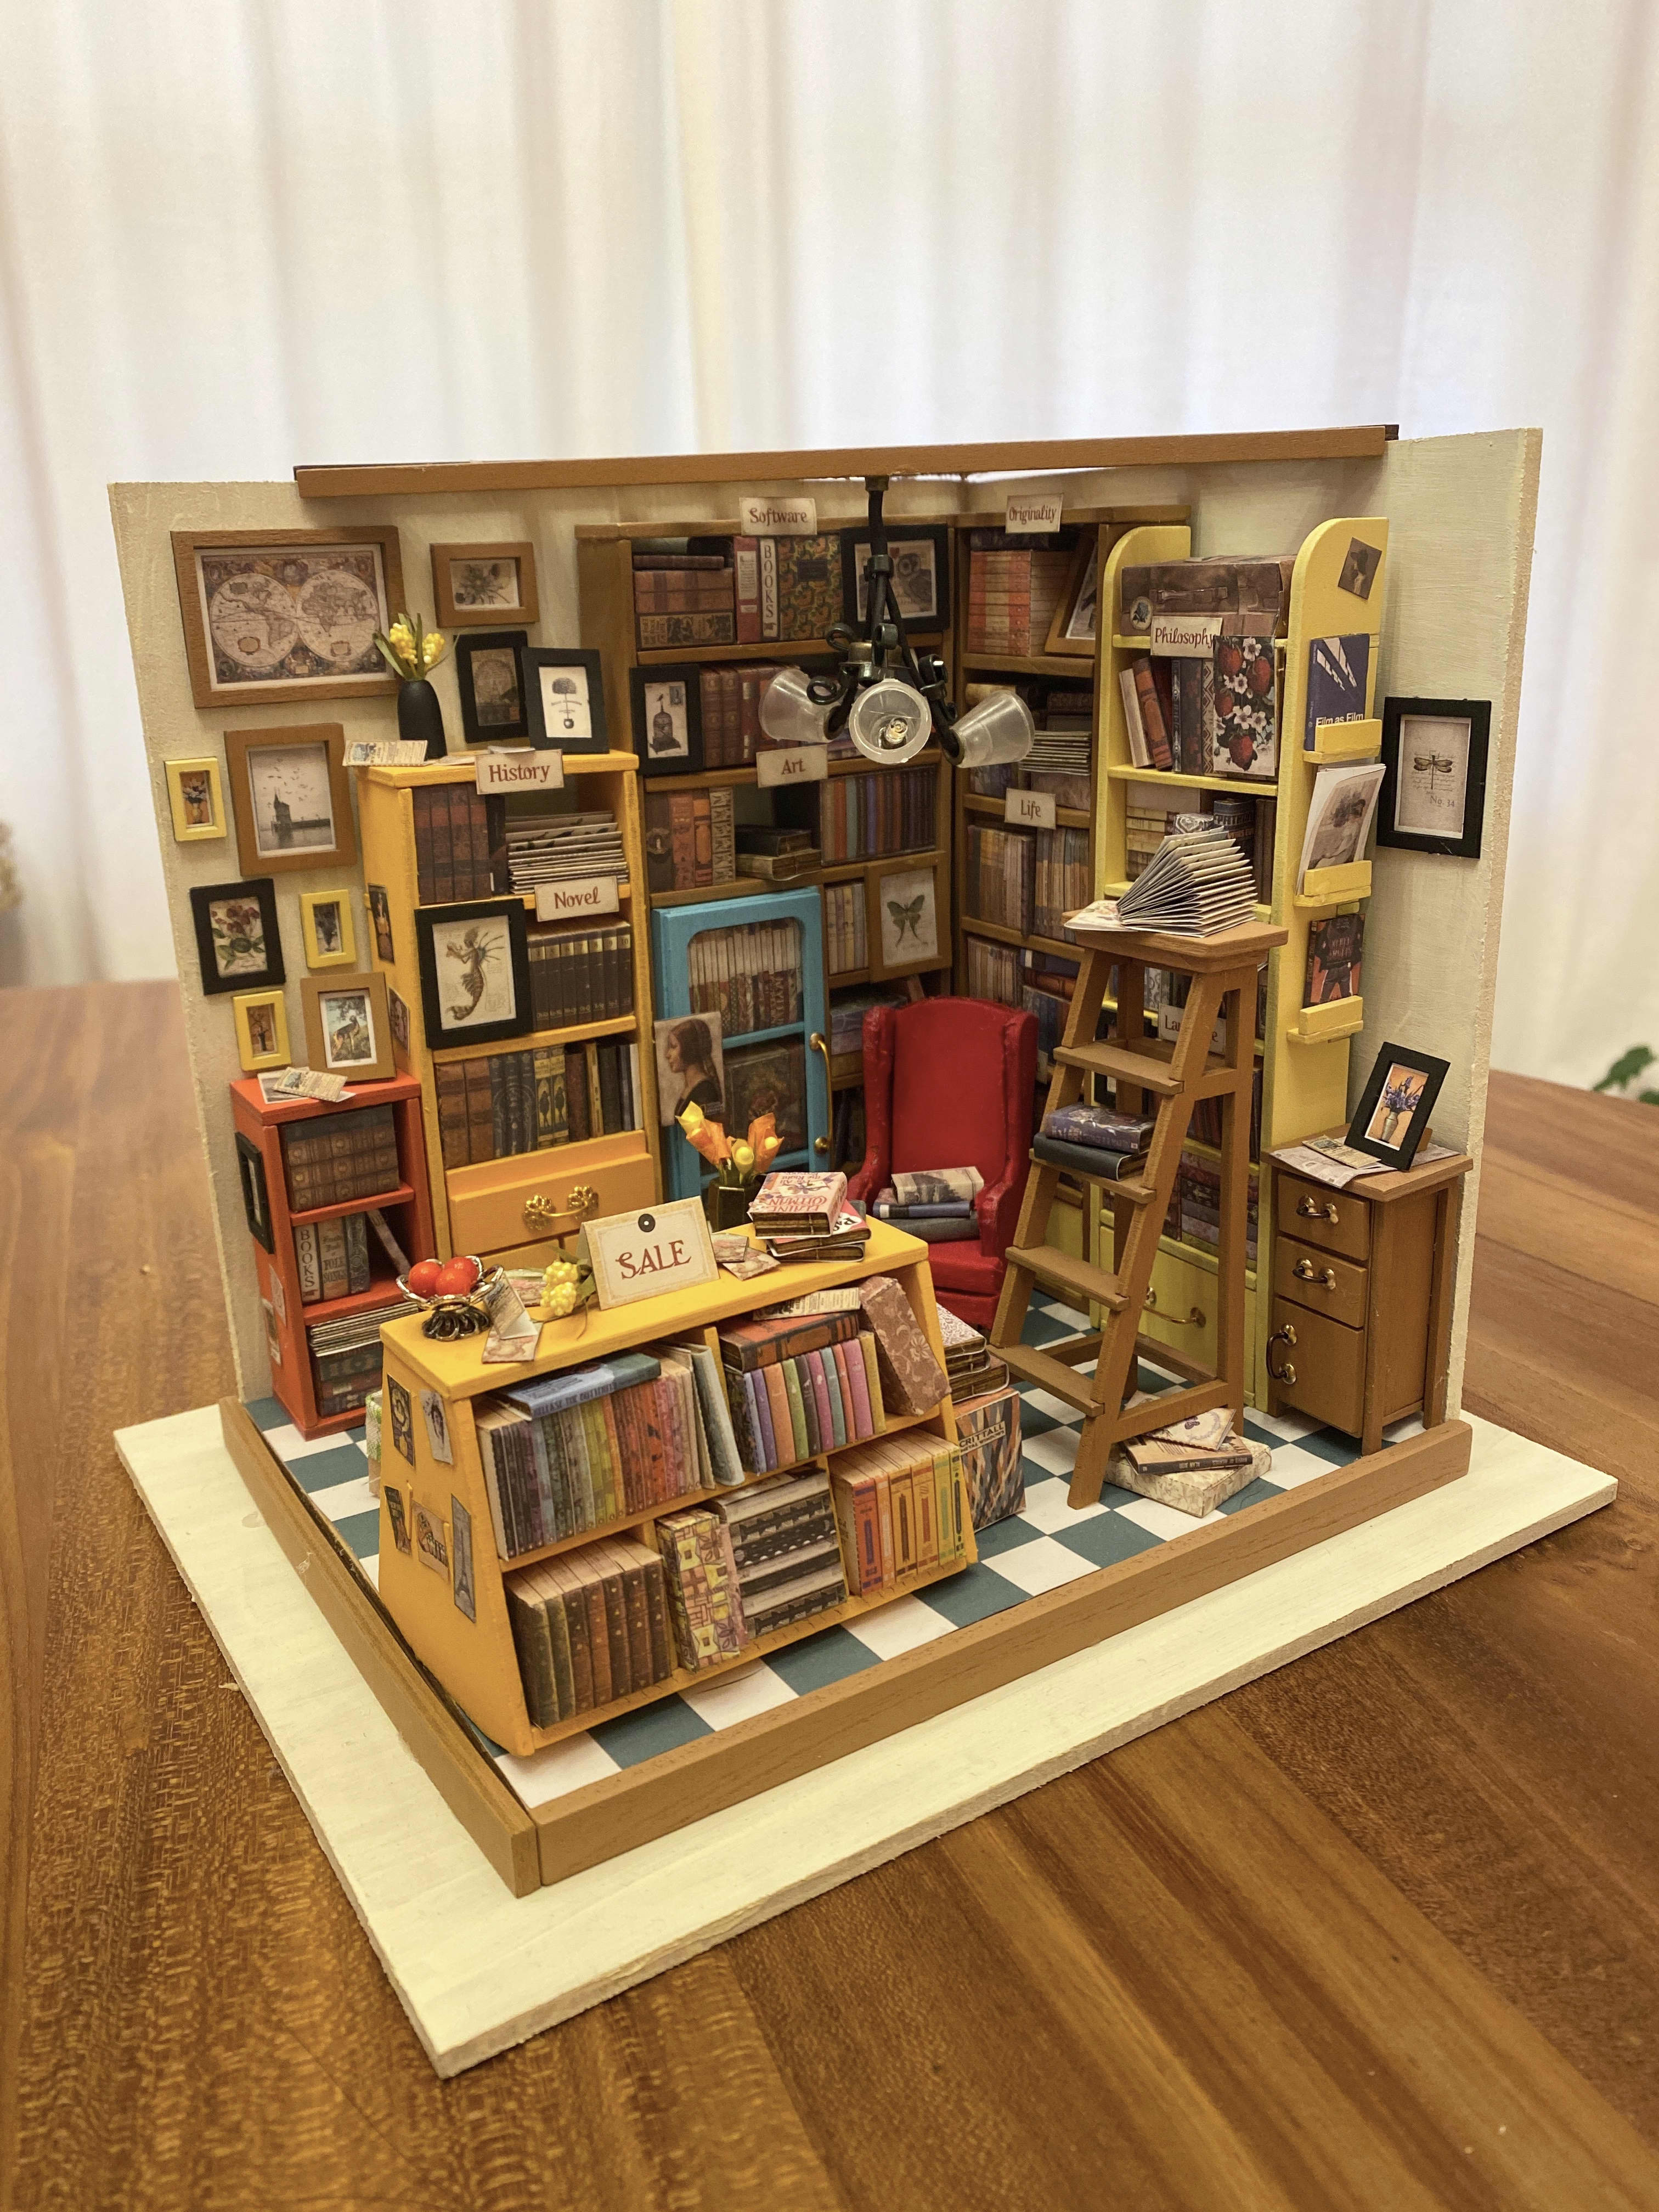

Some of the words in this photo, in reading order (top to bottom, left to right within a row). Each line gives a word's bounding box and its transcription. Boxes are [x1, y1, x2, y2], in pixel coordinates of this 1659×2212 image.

[749, 507, 808, 527] Software
[1009, 505, 1057, 525] Originality
[764, 545, 774, 618] BOOKS
[1155, 627, 1215, 648] Philosophy
[1316, 716, 1333, 726] Film
[1346, 712, 1364, 721] Film
[488, 764, 550, 783] History
[781, 758, 806, 775] Art
[1021, 799, 1041, 820] Life
[1430, 795, 1445, 805] No.
[1447, 799, 1455, 808] 34
[554, 886, 601, 910] Novel
[301, 1229, 315, 1288] BOOKS
[615, 1240, 692, 1280] SALE
[959, 1424, 1004, 1447] CRITTALL
